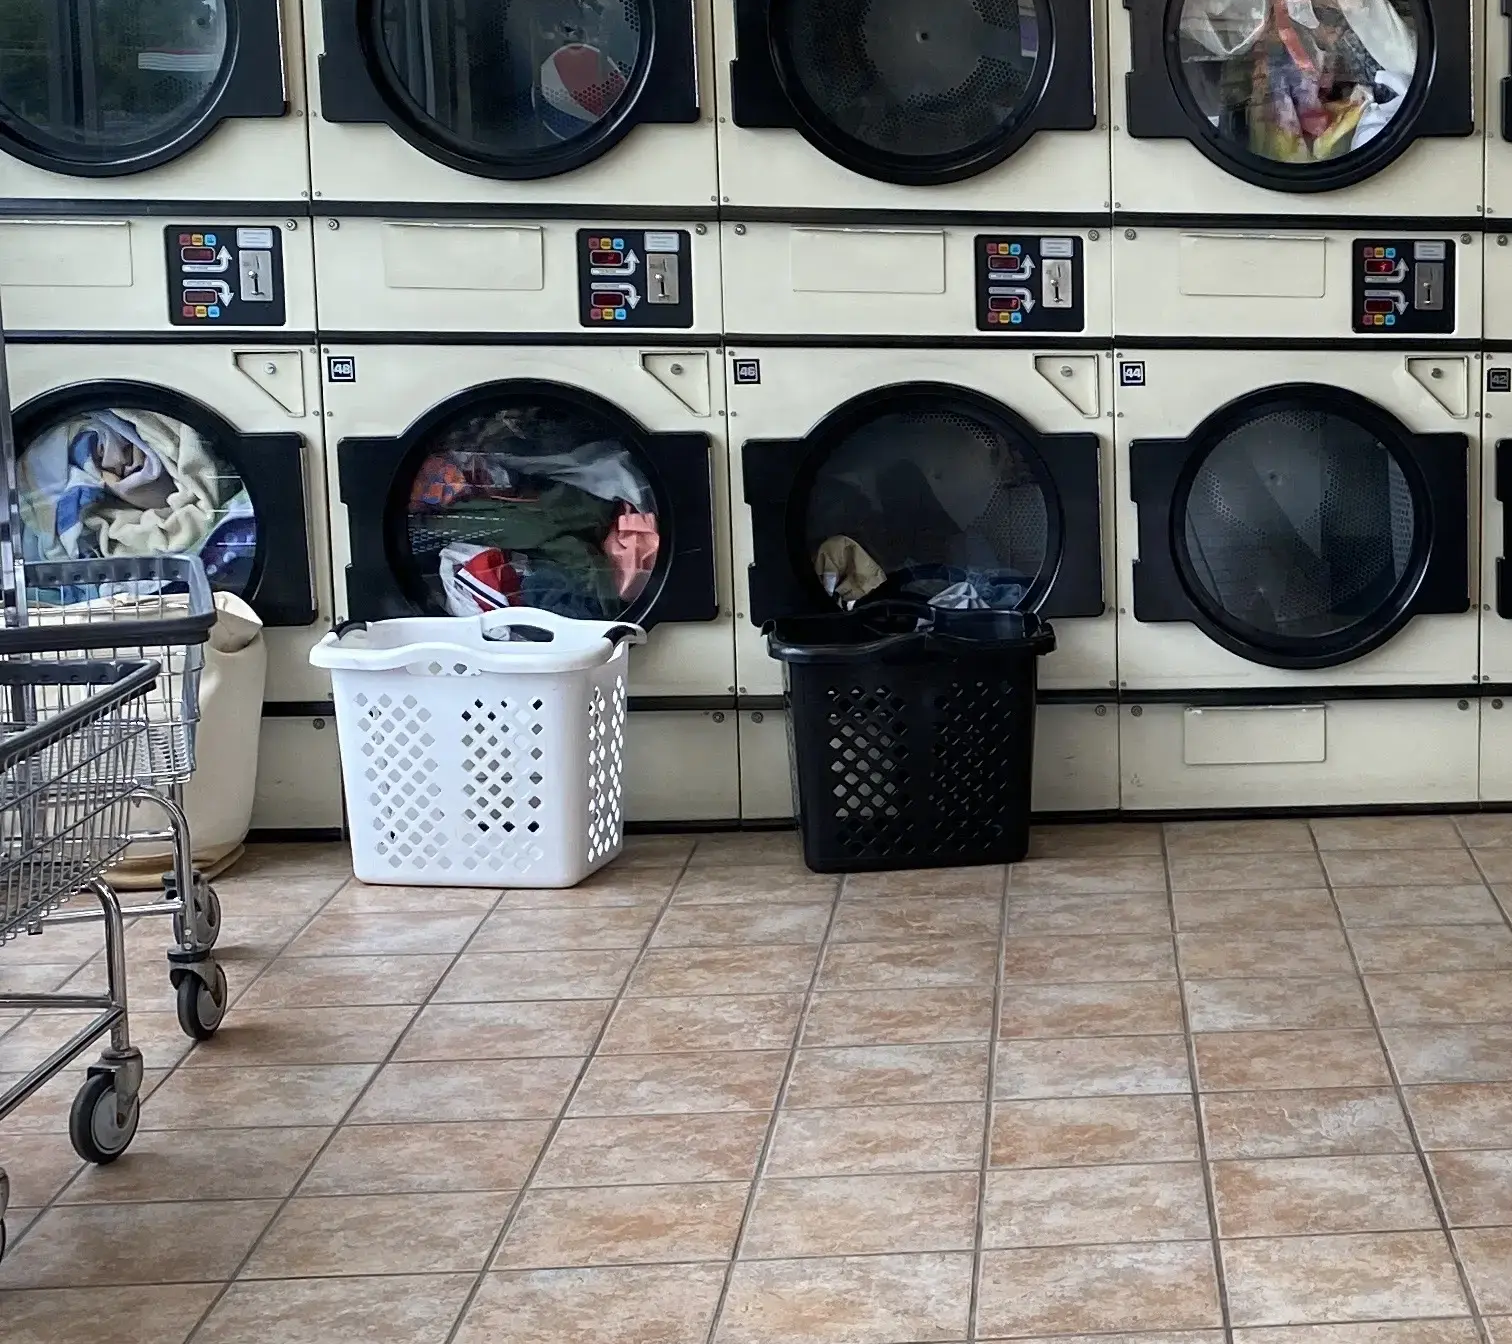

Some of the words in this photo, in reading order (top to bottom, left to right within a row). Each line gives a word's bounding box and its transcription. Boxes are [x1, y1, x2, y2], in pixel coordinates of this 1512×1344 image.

[740, 367, 756, 376] 46
[1126, 367, 1142, 378] 44
[1492, 374, 1508, 385] 42
